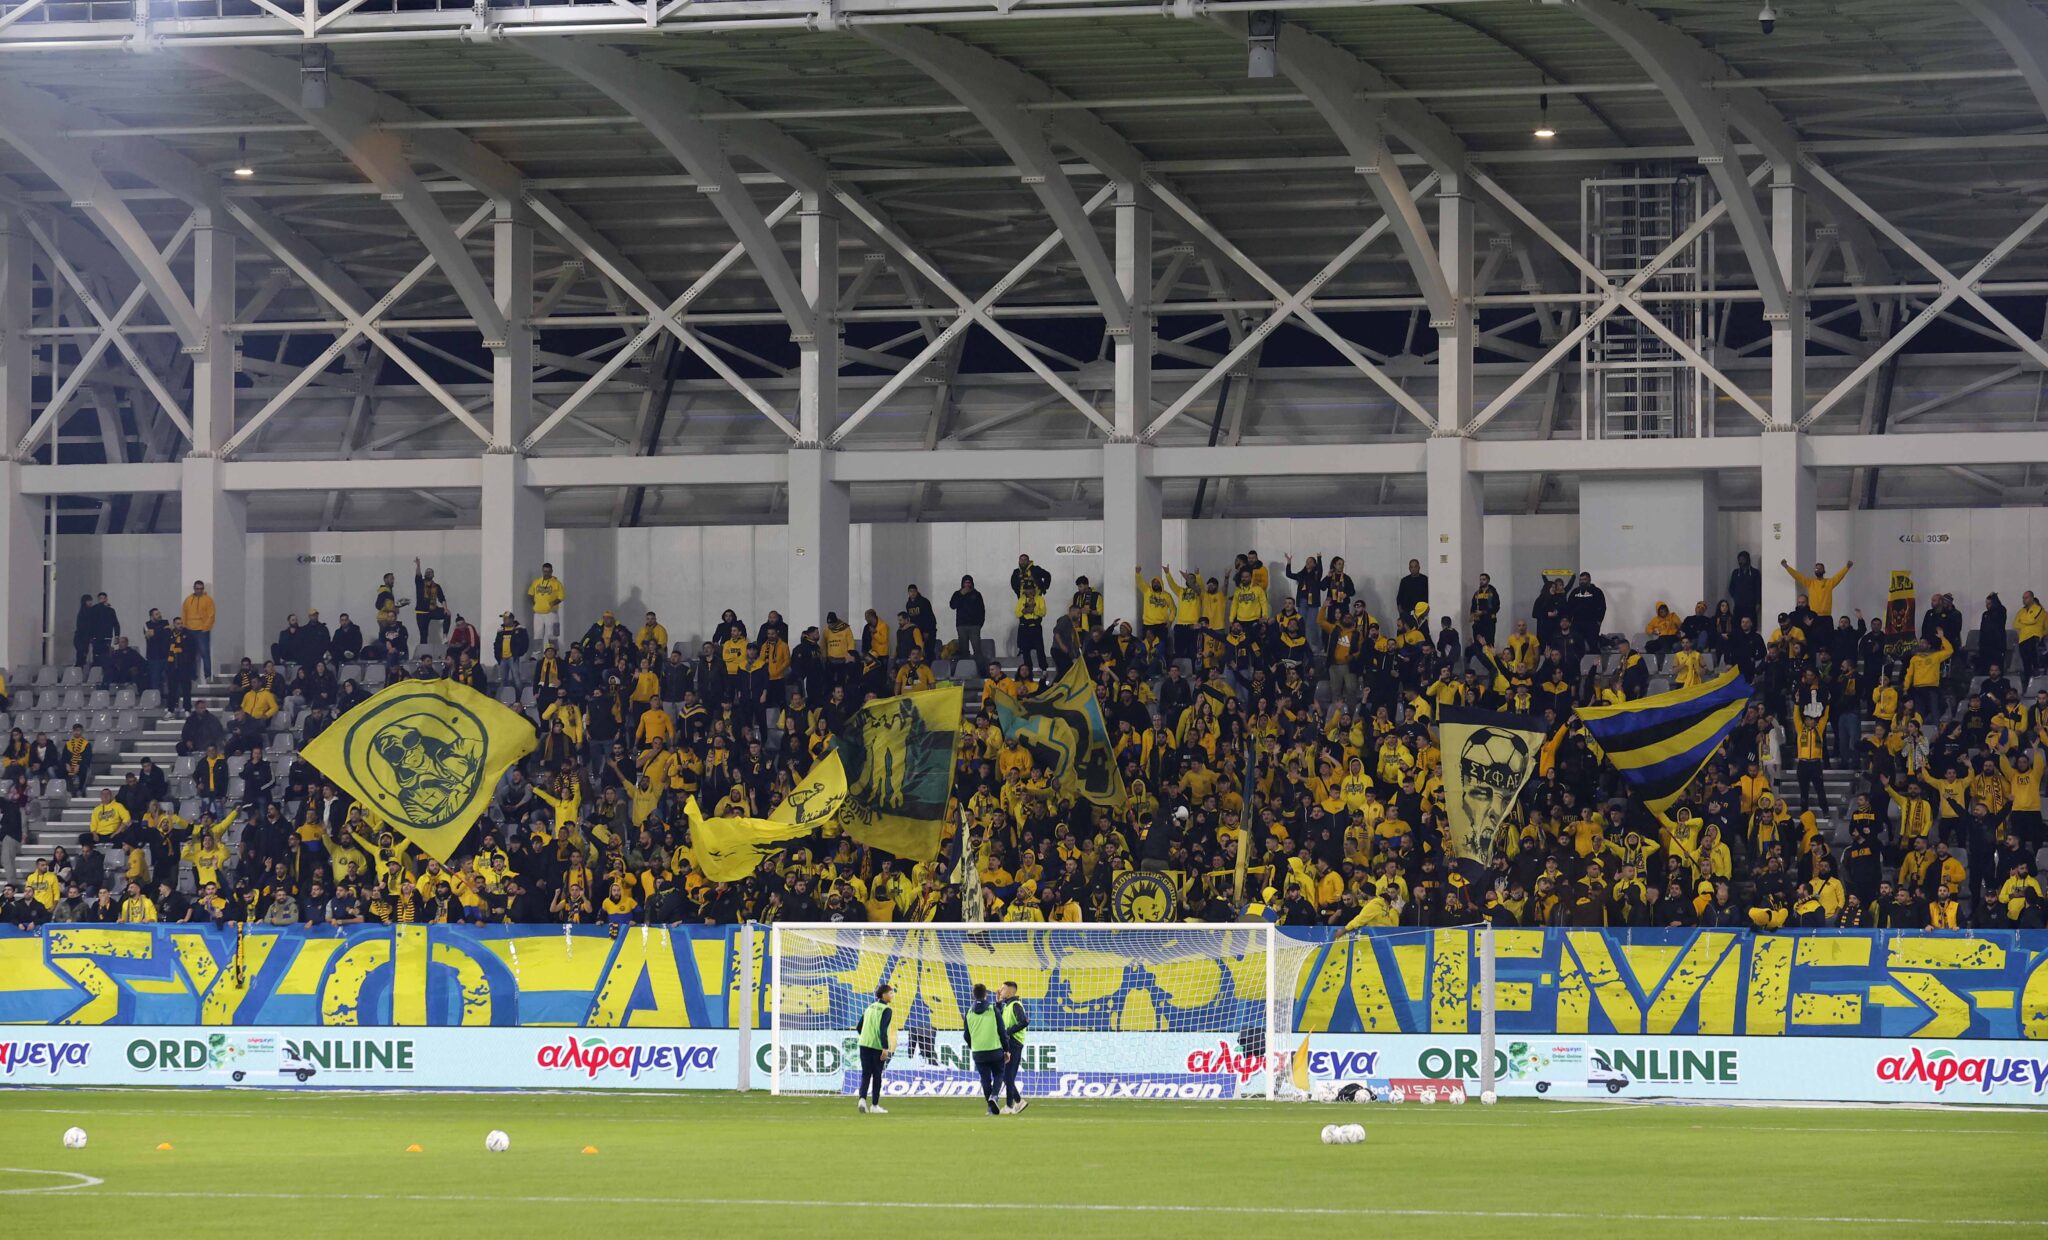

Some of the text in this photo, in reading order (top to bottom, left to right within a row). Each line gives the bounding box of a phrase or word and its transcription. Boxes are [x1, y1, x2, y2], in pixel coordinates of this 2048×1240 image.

[1298, 928, 2048, 1037] ΛΕΜΕΣ
[127, 1040, 207, 1069] ORD
[537, 1036, 717, 1077] αλφαμεγα
[1418, 1048, 1508, 1079] ORD
[1048, 1073, 1222, 1097] Stoiximan
[1393, 1084, 1463, 1095] NISSAN
